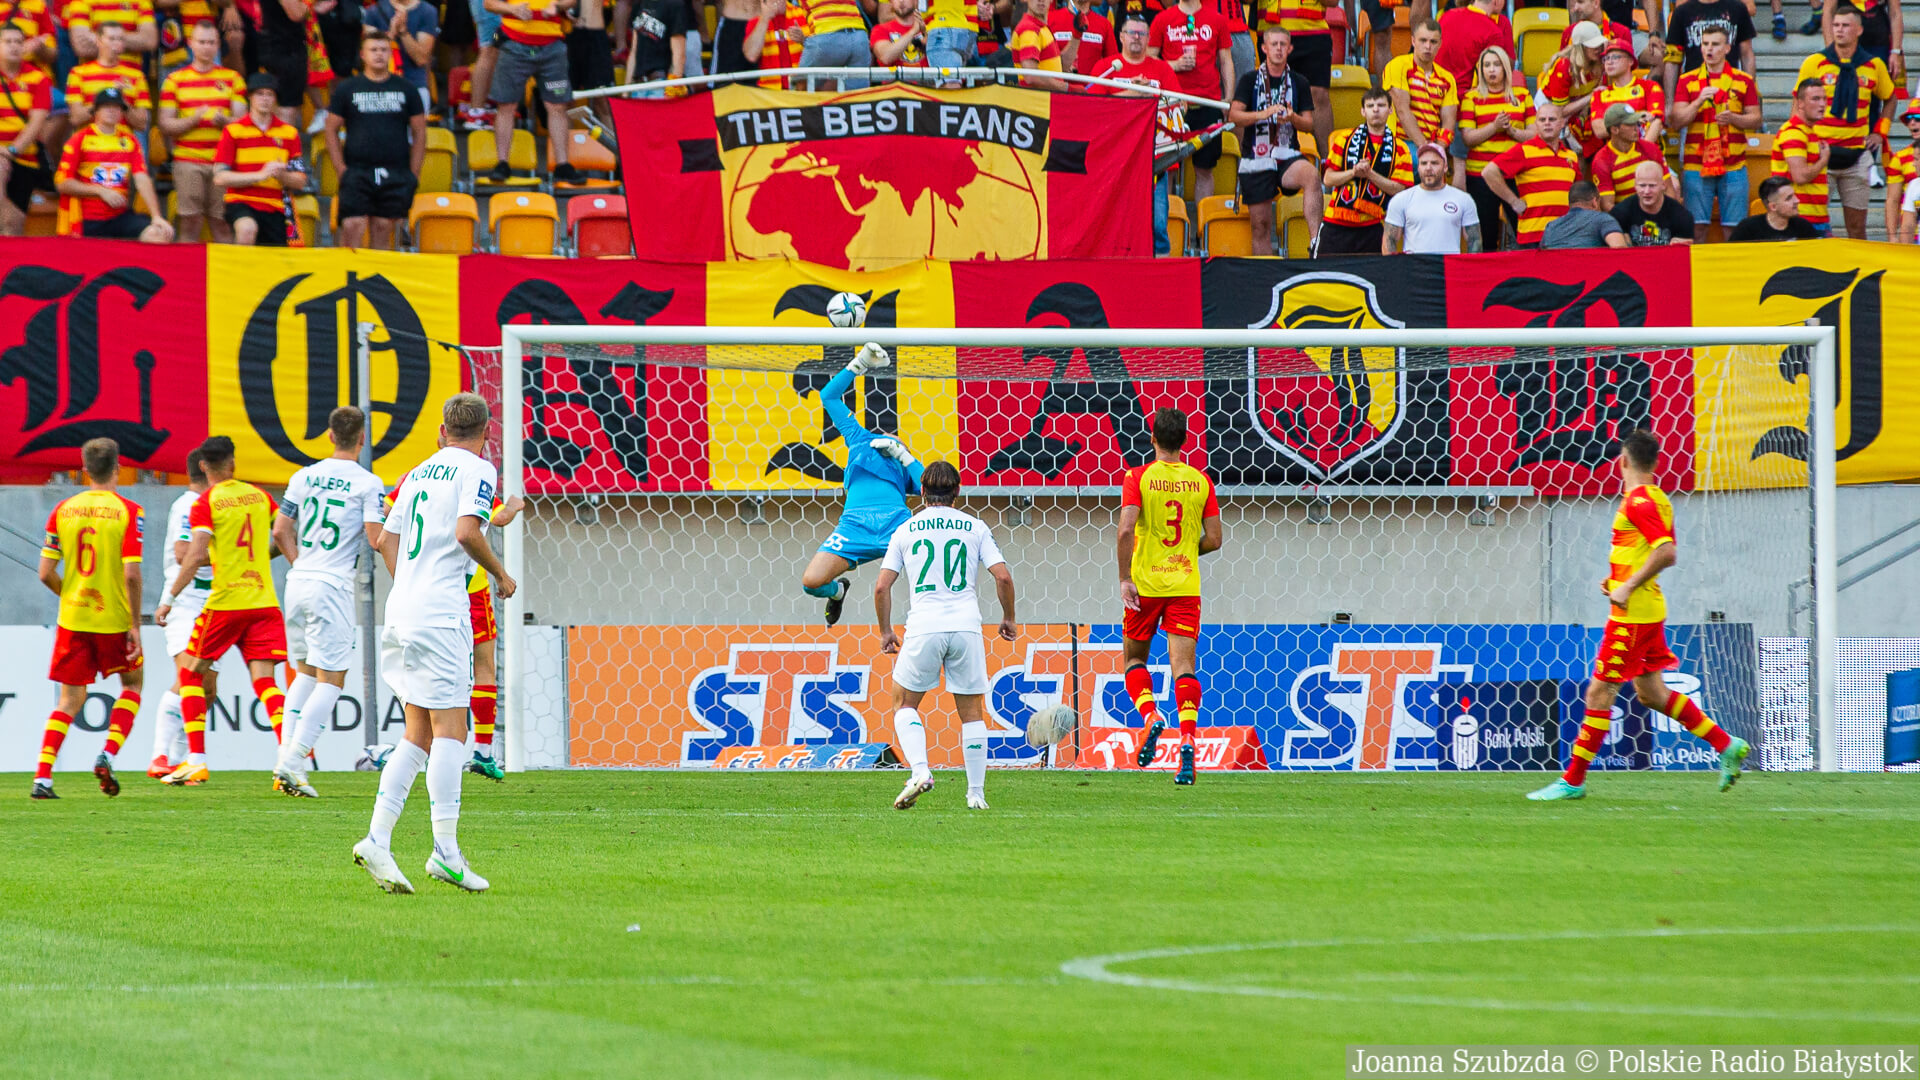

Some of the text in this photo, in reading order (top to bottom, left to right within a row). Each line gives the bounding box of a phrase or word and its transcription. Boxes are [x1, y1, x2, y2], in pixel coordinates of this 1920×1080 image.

[728, 100, 1035, 149] THE BEST FANS
[305, 475, 351, 492] NALEPA
[1149, 479, 1200, 493] AUGUSTYN
[236, 513, 254, 562] 4
[302, 496, 345, 551] 25
[407, 490, 428, 560] 6
[823, 532, 849, 551] 55
[909, 518, 972, 532] CONRADO
[1162, 500, 1183, 547] 3
[77, 526, 96, 577] 6
[912, 538, 967, 592] 20
[680, 643, 870, 768] STS
[1154, 742, 1223, 764] OREN
[1484, 727, 1545, 748] Bank Polski
[1677, 747, 1721, 763] Polsk
